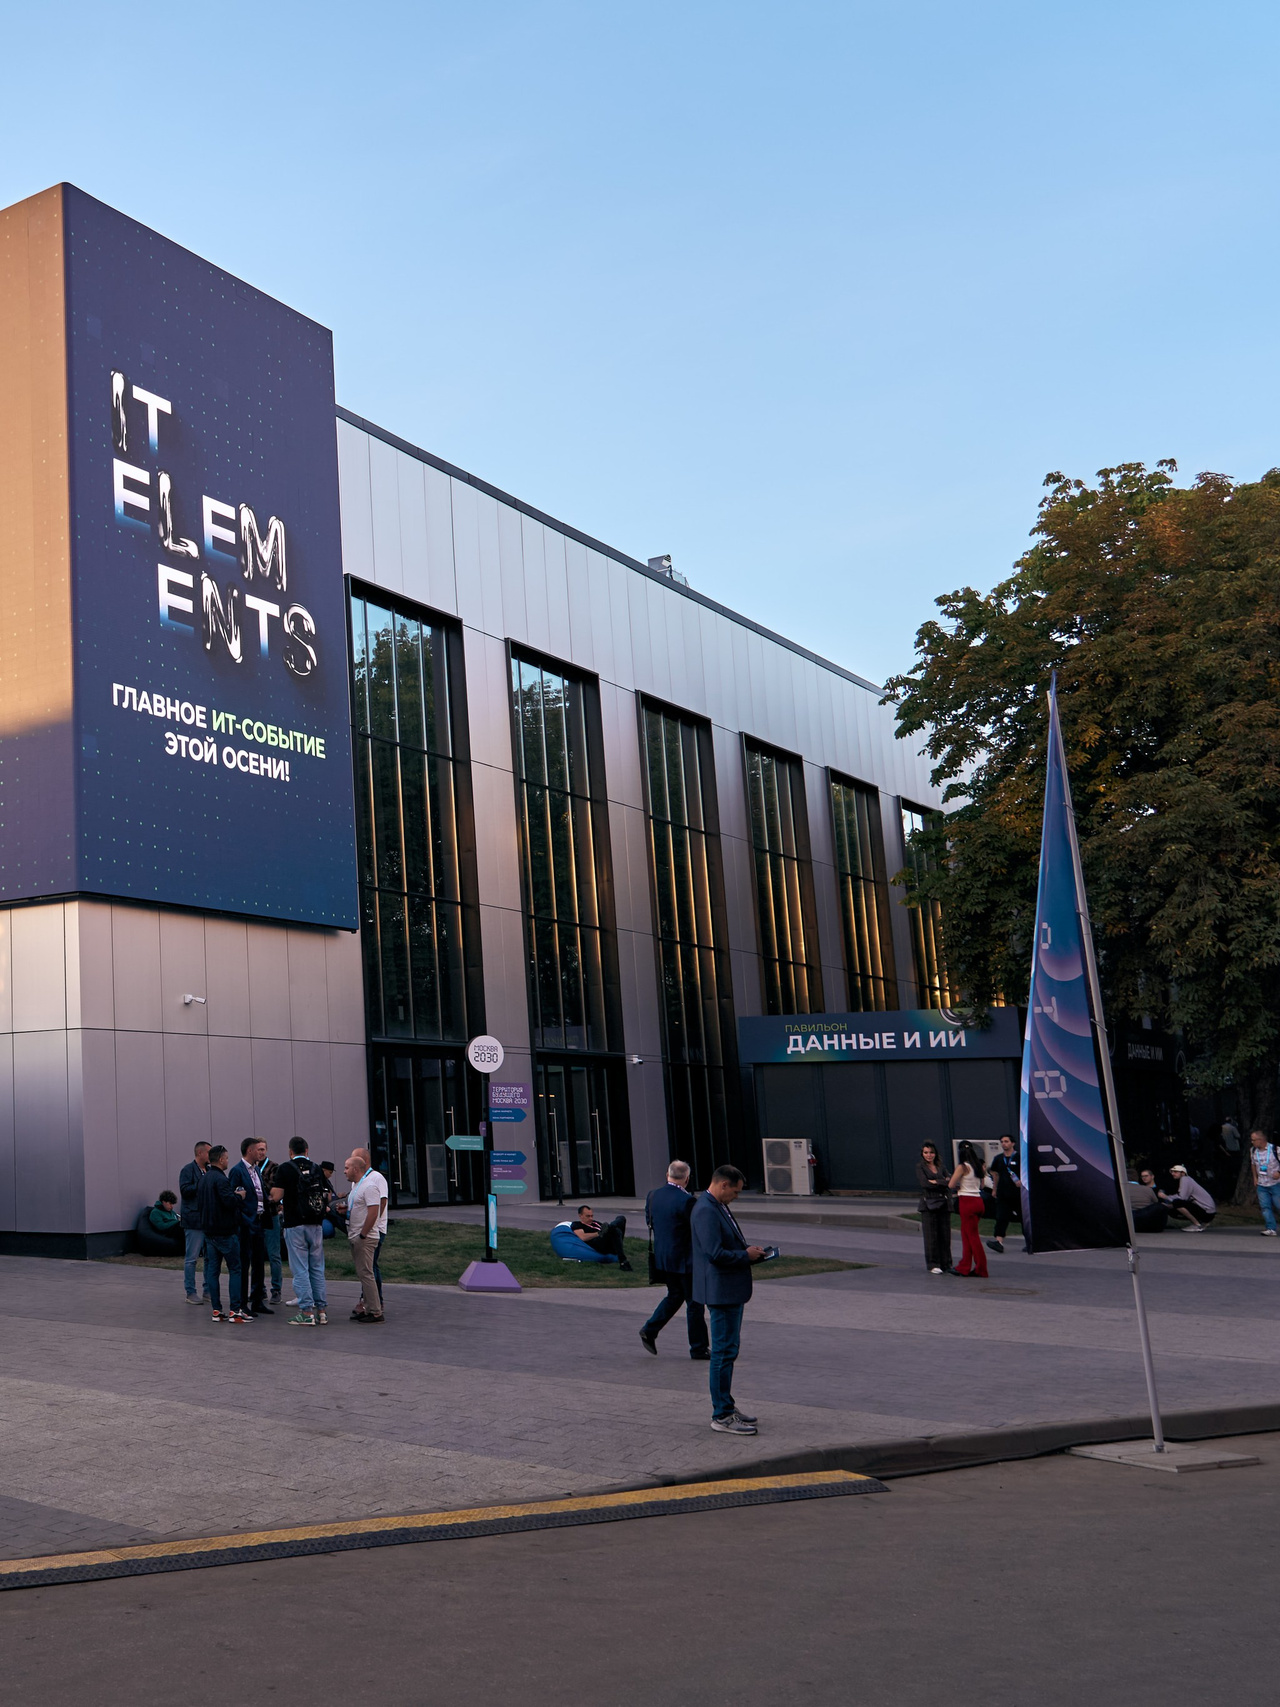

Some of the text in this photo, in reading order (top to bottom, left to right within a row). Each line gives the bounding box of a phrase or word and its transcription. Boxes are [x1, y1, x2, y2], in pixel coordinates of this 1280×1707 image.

[110, 370, 172, 454] IT
[112, 457, 287, 591] ELEM
[157, 563, 318, 676] ENTS
[112, 682, 327, 759] ГЛАВНОЕ ИТ-СОБЫТИЕ
[164, 731, 291, 782] ЭТОЙ ОСЕНИ!
[474, 1051, 499, 1063] 2030
[784, 1022, 848, 1033] ПАВИЛЬОН
[786, 1029, 967, 1055] ДАННЫЕ И ИИ
